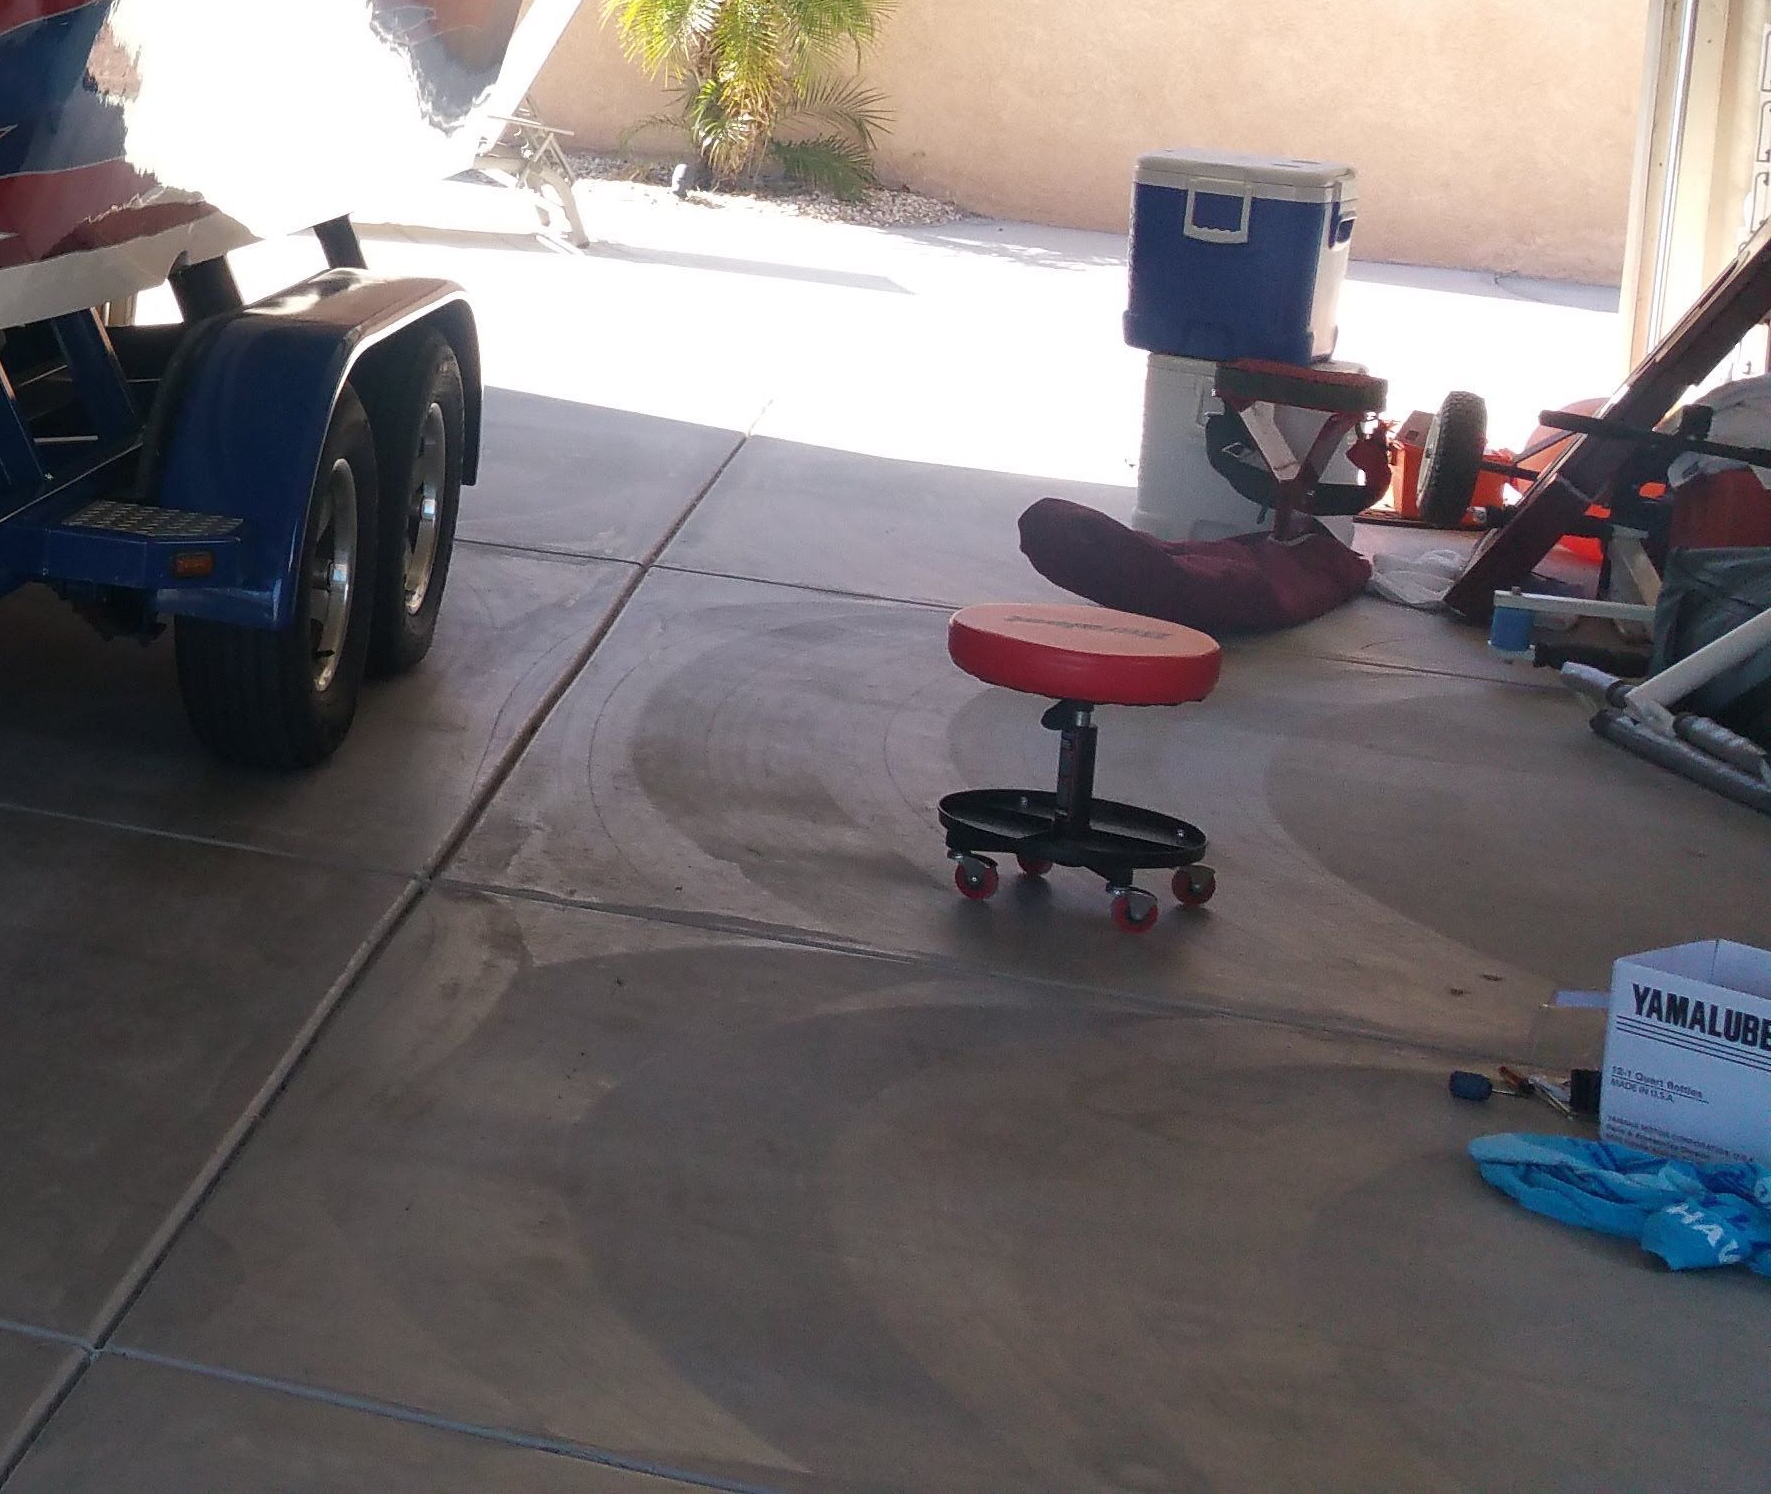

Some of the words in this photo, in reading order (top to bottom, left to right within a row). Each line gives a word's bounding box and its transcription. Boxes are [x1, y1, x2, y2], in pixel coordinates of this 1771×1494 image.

[1632, 983, 1771, 1052] YAMALUBE
[1610, 1078, 1637, 1093] MADE
[1635, 1072, 1664, 1087] Quart
[1667, 1081, 1703, 1098] Bottles
